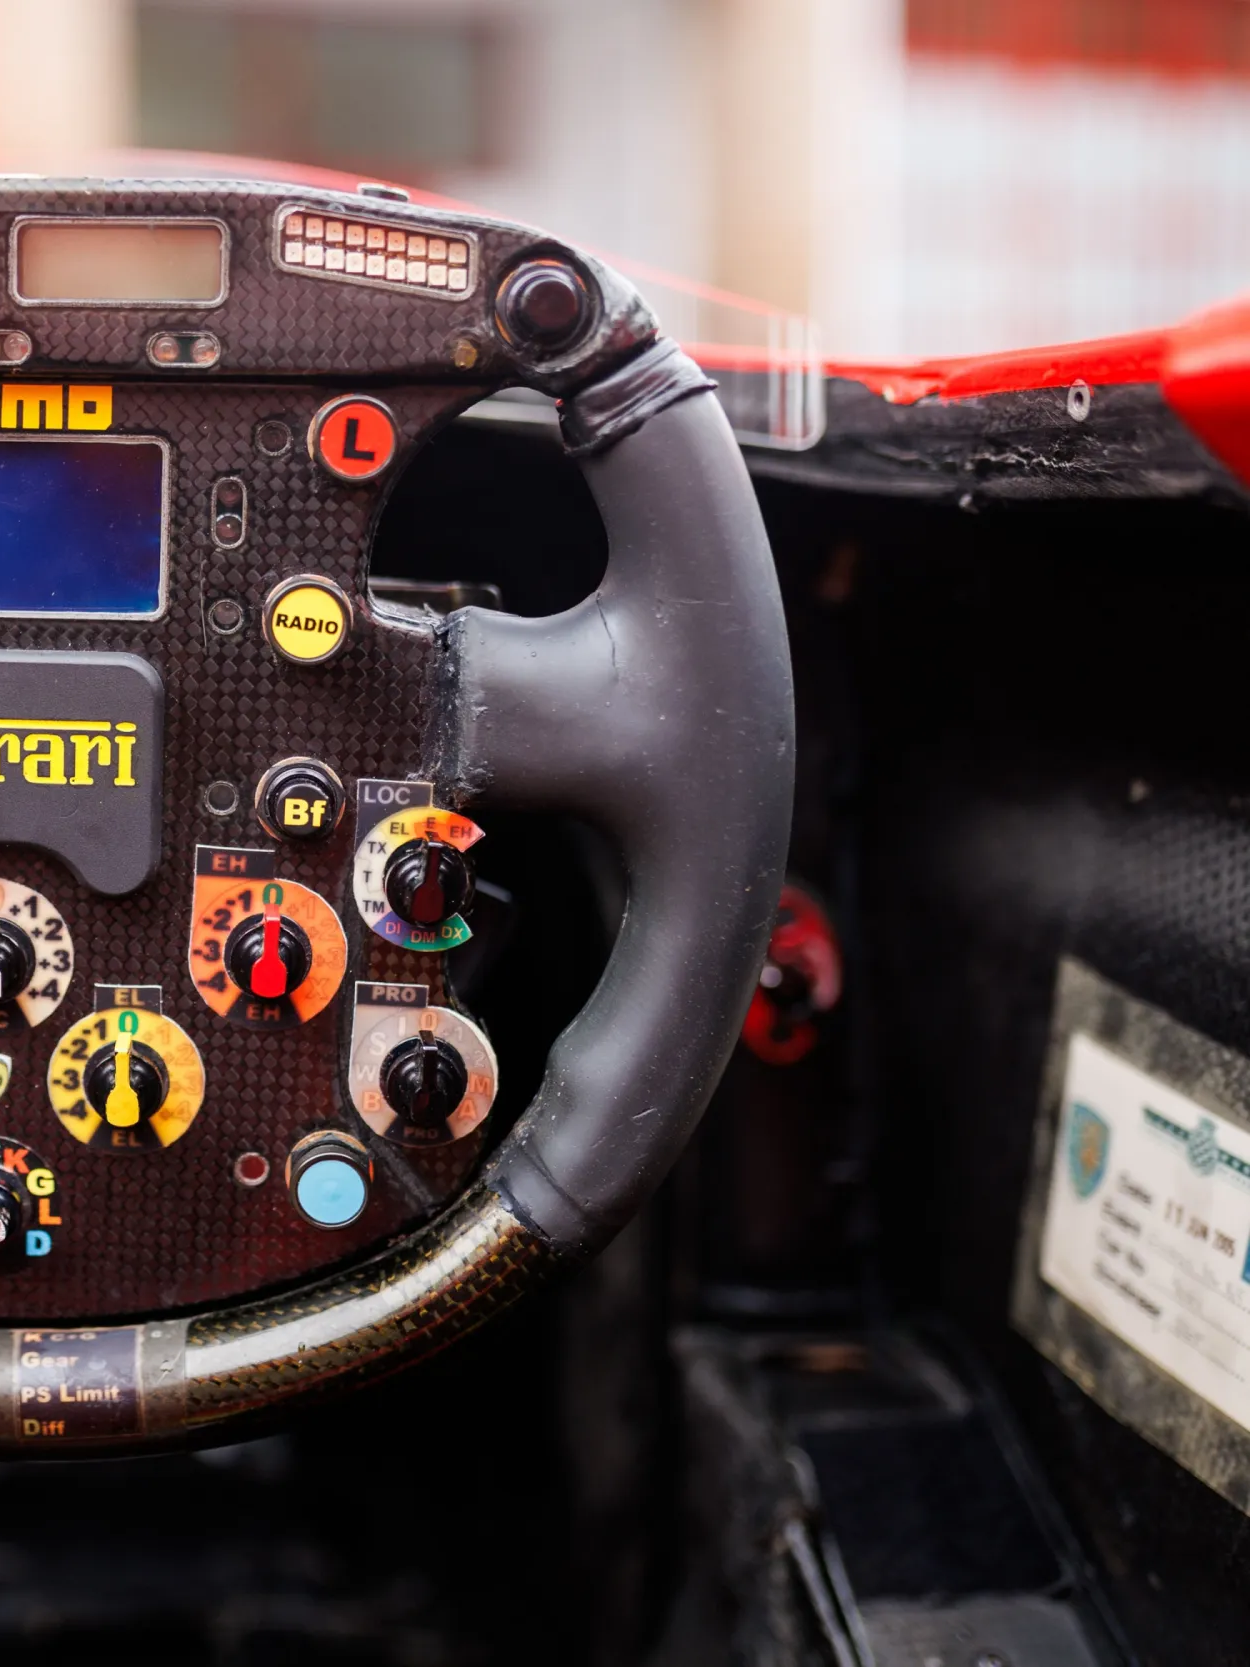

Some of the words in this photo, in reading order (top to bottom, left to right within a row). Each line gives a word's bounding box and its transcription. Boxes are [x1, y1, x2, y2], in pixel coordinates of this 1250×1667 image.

[342, 417, 376, 461] L
[275, 613, 338, 635] RADIO
[363, 785, 411, 805] LOC
[283, 798, 327, 827] Bf
[390, 822, 410, 835] EL
[450, 825, 472, 839] EH
[367, 841, 388, 855] TX
[211, 853, 248, 873] EH
[363, 870, 372, 883] T
[10, 895, 38, 918] +1
[225, 889, 253, 912] -1
[362, 900, 385, 914] TM
[31, 918, 63, 941] +2
[203, 909, 232, 931] -2
[411, 930, 436, 943] DM
[441, 926, 464, 940] DX
[39, 950, 71, 973] +3
[193, 939, 221, 962] -3
[28, 978, 60, 1001] +4
[198, 971, 227, 993] -4
[113, 988, 146, 1007] EL
[371, 986, 417, 1003] PRO
[245, 1003, 281, 1022] EH
[82, 1018, 108, 1041] -1
[60, 1038, 89, 1061] -2
[369, 1032, 387, 1057] S
[52, 1068, 80, 1091] -3
[354, 1065, 379, 1082] W
[470, 1073, 491, 1097] M
[59, 1099, 88, 1120] -4
[362, 1091, 382, 1113] B
[458, 1099, 477, 1119] A
[111, 1129, 142, 1148] EL
[3, 1148, 31, 1174] K
[26, 1168, 56, 1196] G
[38, 1198, 62, 1225] L
[25, 1230, 52, 1257] D
[21, 1351, 79, 1369] Gear
[21, 1386, 52, 1404] PS
[59, 1383, 121, 1403] Limit
[22, 1418, 66, 1437] Diff
